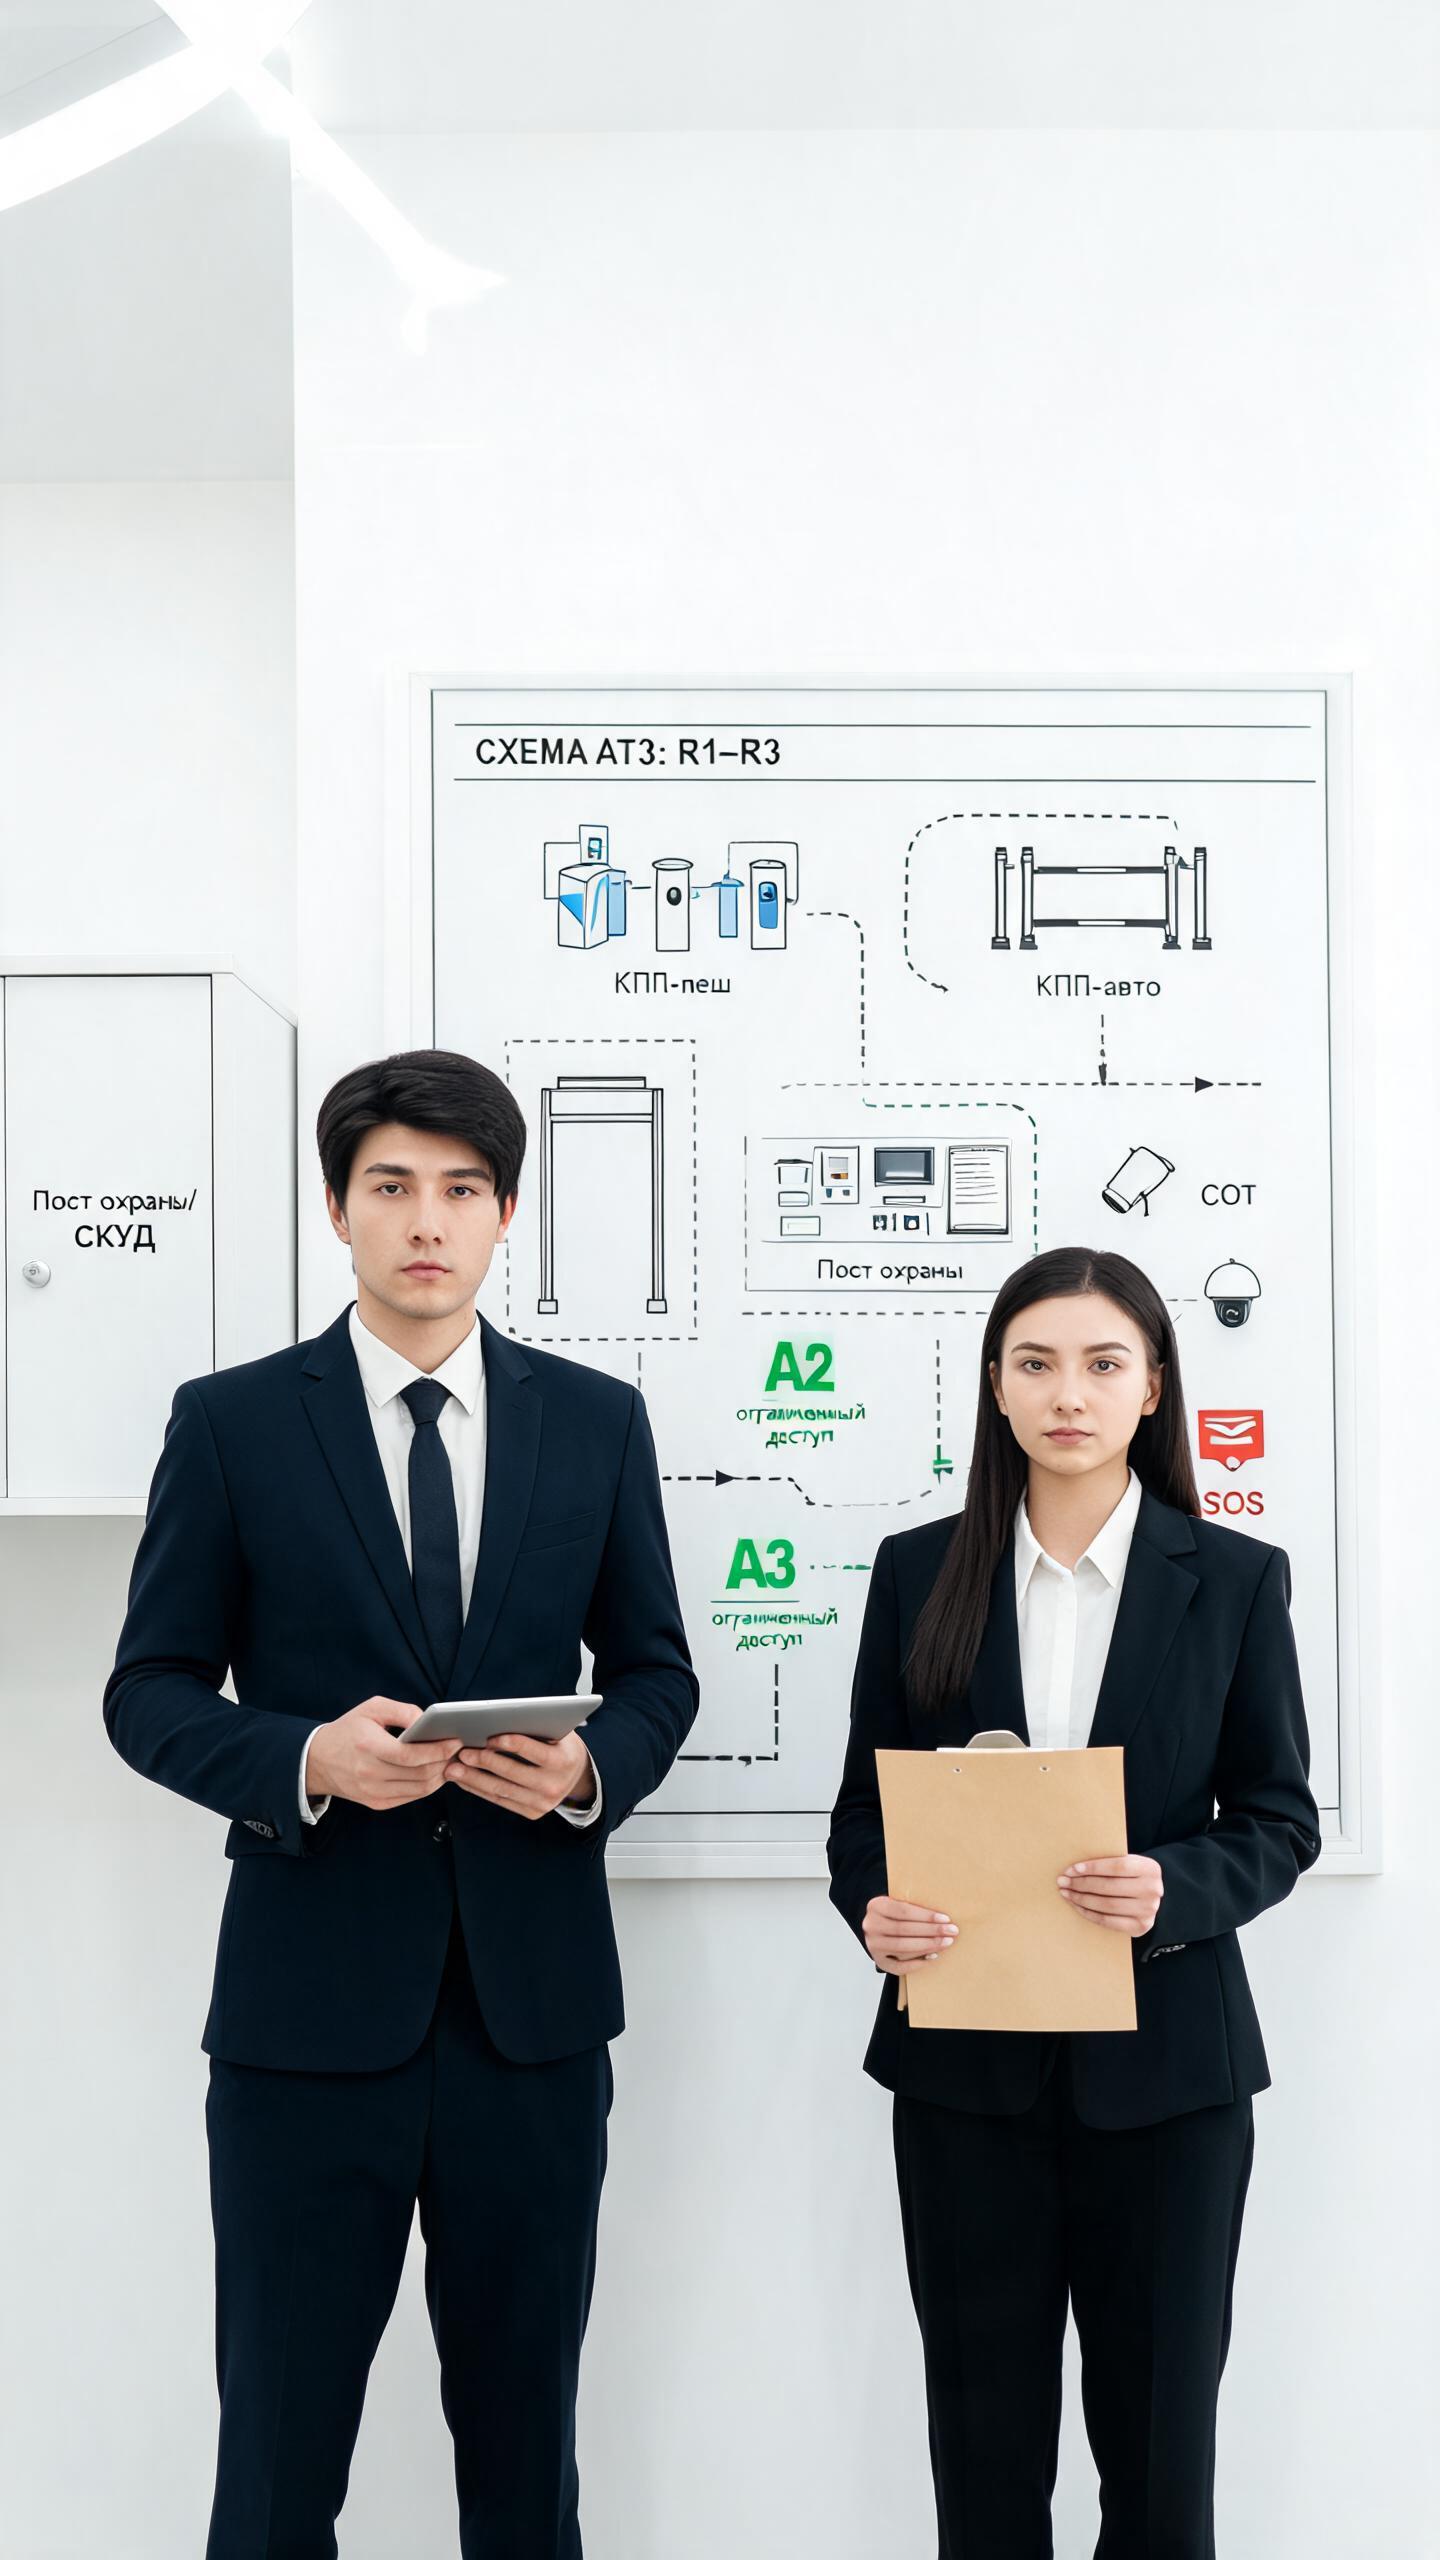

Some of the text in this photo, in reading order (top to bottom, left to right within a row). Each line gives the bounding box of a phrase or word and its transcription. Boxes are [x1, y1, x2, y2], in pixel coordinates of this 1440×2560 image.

[476, 738, 588, 765] СХЕМА
[615, 971, 731, 994] КПП-пеш
[1037, 974, 1162, 997] КПП-авто
[33, 1188, 198, 1216] Пост охраны/
[1200, 1183, 1257, 1207] СОТ
[74, 1224, 156, 1254] СКУД
[817, 1258, 963, 1285] Пост охраны
[1203, 1491, 1265, 1516] SOS
